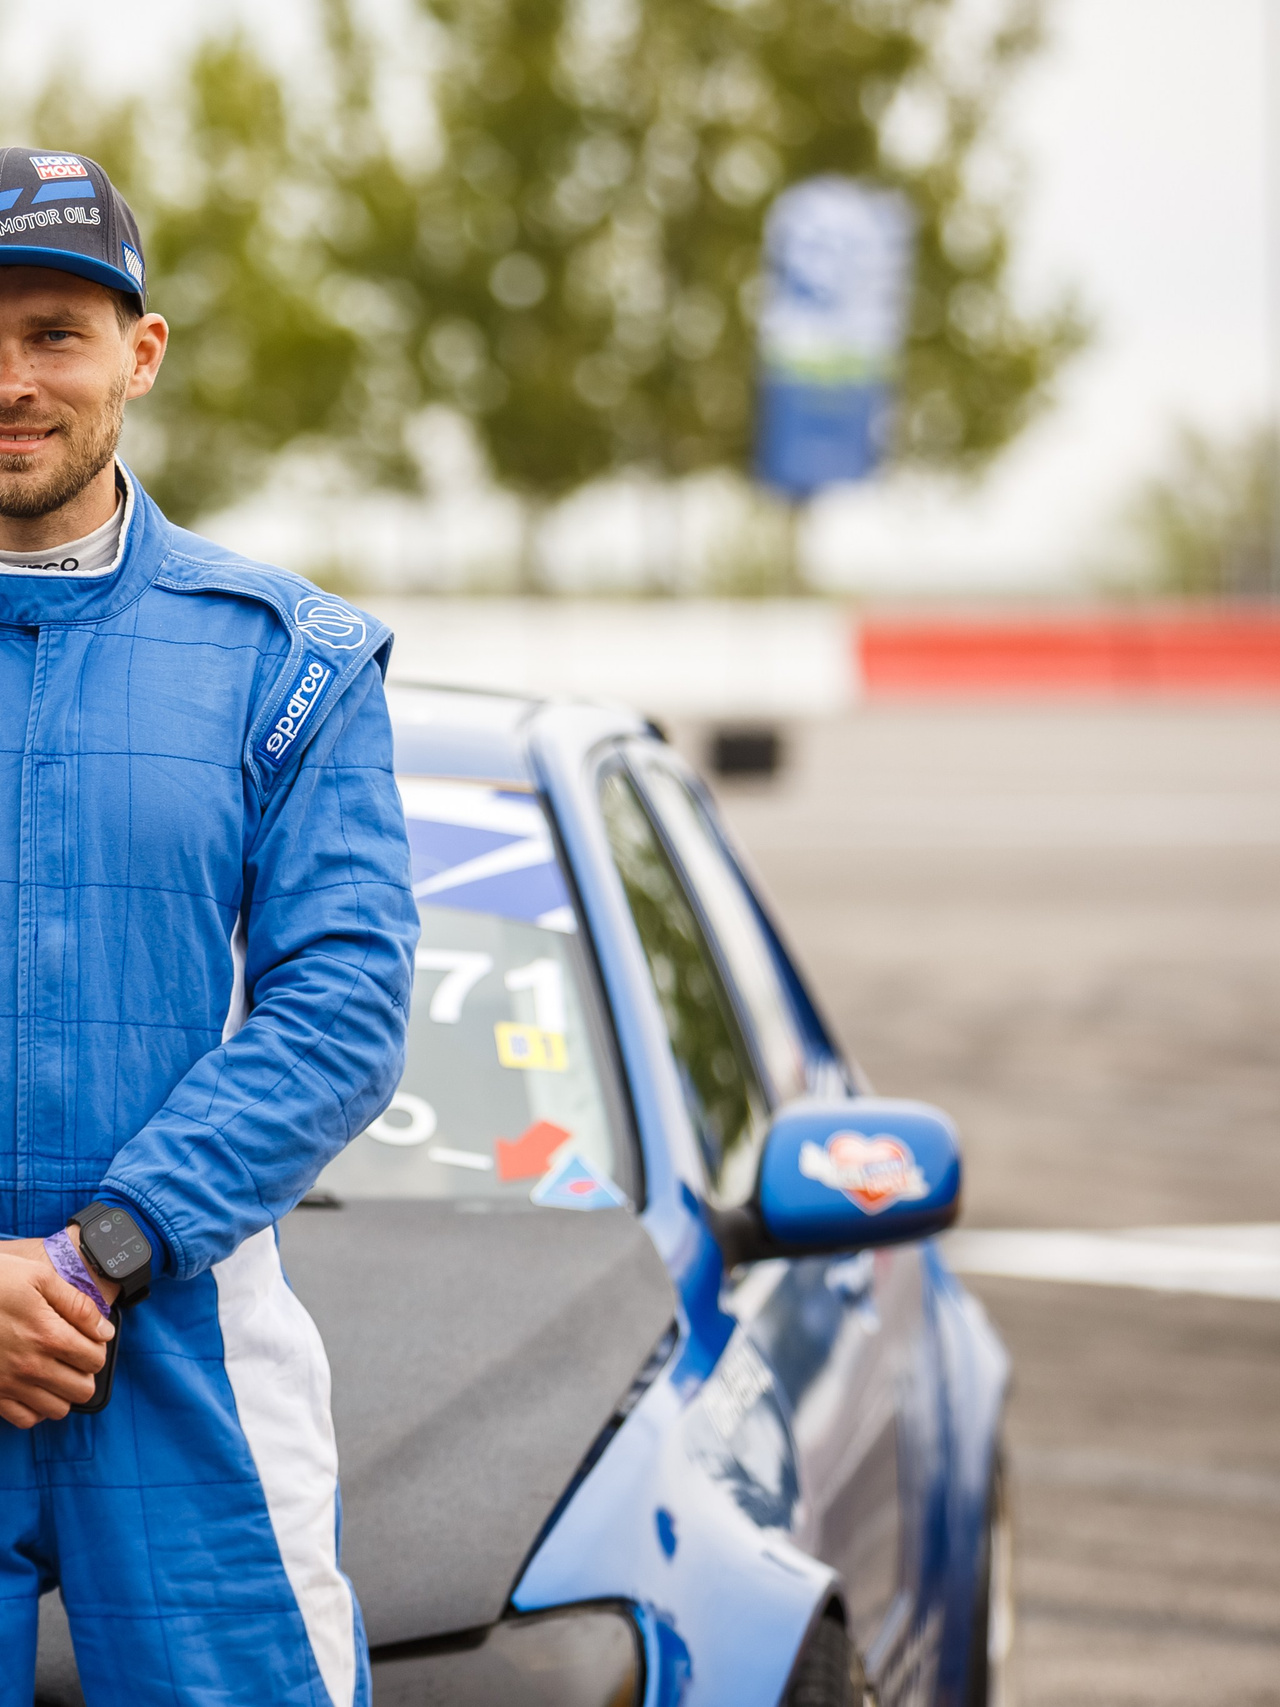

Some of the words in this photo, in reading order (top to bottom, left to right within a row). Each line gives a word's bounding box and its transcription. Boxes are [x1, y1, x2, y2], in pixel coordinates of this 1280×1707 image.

[32, 157, 79, 167] LIQUI
[39, 165, 82, 177] MOLY
[63, 207, 101, 225] OILS
[266, 662, 324, 752] sparco
